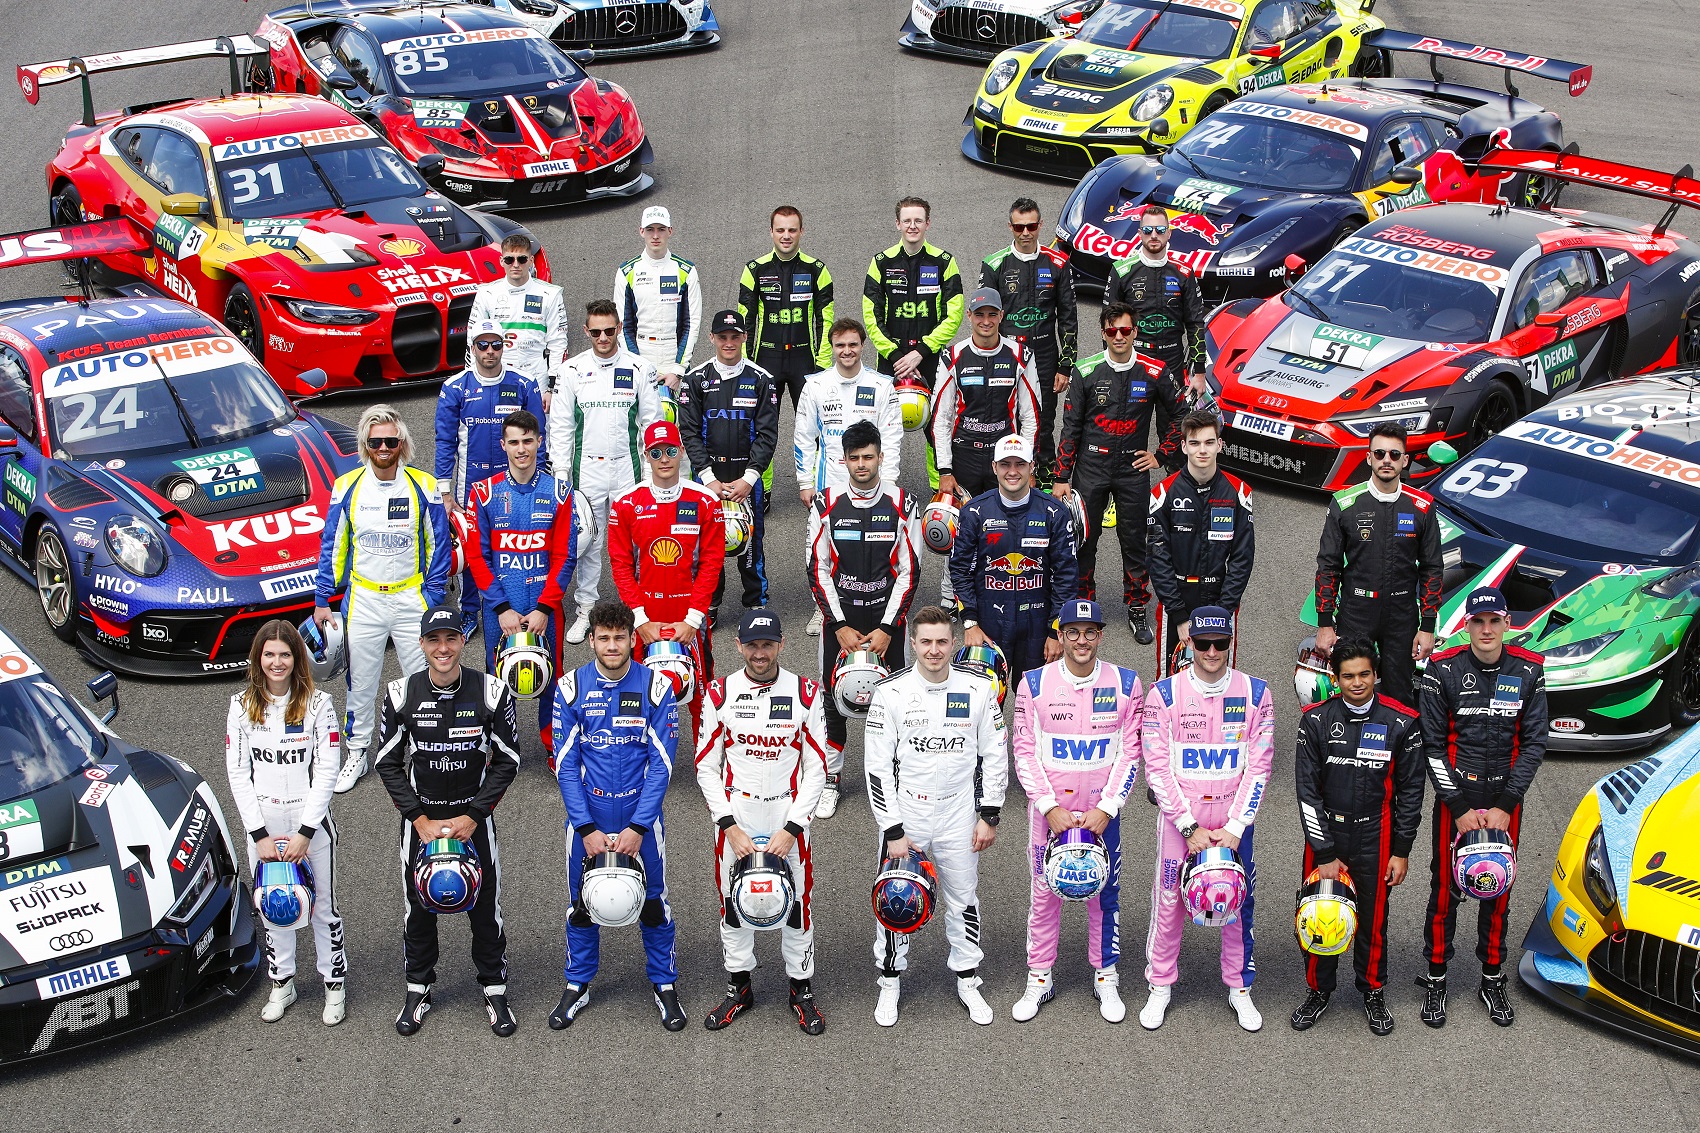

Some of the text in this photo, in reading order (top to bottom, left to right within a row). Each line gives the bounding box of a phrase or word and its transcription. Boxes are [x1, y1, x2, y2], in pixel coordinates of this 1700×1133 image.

[972, 1, 1004, 11] MAHLE
[1350, 23, 1369, 37] SSR
[400, 29, 528, 50] AUTOHERO
[394, 49, 449, 75] 85
[1096, 49, 1142, 60] DEKRA
[1408, 38, 1547, 71] Red Bull
[1084, 64, 1114, 74] DTM
[1300, 60, 1322, 82] EDAG
[1243, 70, 1283, 96] 94 DEKRA
[1571, 79, 1587, 91] avd.de
[1052, 89, 1104, 103] EDAG
[415, 100, 464, 110] DEKRA
[427, 108, 449, 118] 85
[421, 119, 456, 127] DTM
[1023, 118, 1058, 132] MAHLE
[1229, 102, 1360, 135] AUTOHERO
[1184, 120, 1245, 148] 74
[222, 126, 369, 159] AUTOHERO
[531, 162, 569, 173] MAHLE
[228, 163, 285, 205] 31
[1561, 168, 1630, 184] Audi
[1186, 178, 1233, 194] DEKRA
[1189, 187, 1210, 201] 74
[1171, 196, 1204, 210] DTM
[1378, 190, 1425, 215] 74 DEKRA
[247, 219, 303, 227] DEKRA
[260, 226, 285, 235] 31
[1390, 224, 1427, 235] TEAM
[159, 214, 202, 252] DEKRA 31
[157, 233, 175, 254] DTM
[1073, 224, 1140, 259] Red
[1372, 230, 1496, 260] ROSBERG
[162, 257, 178, 275] Shell
[1344, 239, 1501, 282] AUTOHERO
[377, 265, 416, 280] Shell
[382, 267, 472, 293] HELIX
[1303, 258, 1370, 292] 51
[164, 271, 199, 308] HELIX
[451, 284, 478, 294] MAHLE
[397, 293, 426, 305] MAHLE
[769, 307, 803, 324] #92
[896, 300, 929, 319] #94
[35, 303, 194, 338] PAUL
[1006, 313, 1048, 323] BIO-CIRCLE
[106, 326, 216, 350] Team Bernhard
[1319, 326, 1372, 347] DEKRA
[1323, 341, 1350, 363] 51
[54, 339, 234, 388] AUTOHERO
[1287, 357, 1328, 370] DTM
[1524, 358, 1539, 380] 51
[1543, 343, 1574, 368] DEKRA
[1266, 379, 1294, 388] AIRWAYS
[1274, 370, 1324, 389] AUGSBURG
[1553, 366, 1575, 389] DTM
[580, 401, 631, 409] SCHAEFFLER
[1383, 401, 1424, 410] RAVENOL
[63, 386, 144, 443] 24
[706, 409, 750, 420] CATL
[1240, 415, 1287, 436] MAHLE
[180, 450, 249, 469] DEKRA
[1220, 441, 1301, 473] MEDION
[1522, 428, 1700, 482] AUTOHERO
[5, 466, 33, 495] DEKRA
[207, 463, 241, 482] 24
[1443, 458, 1529, 498] 63
[213, 477, 258, 496] DTM
[6, 493, 27, 517] DTM
[390, 504, 408, 513] DTM
[1214, 516, 1232, 524] DTM
[206, 506, 325, 551] KÜS
[381, 532, 409, 547] BUSCH
[260, 556, 317, 572] SIEGERDESIGNS
[500, 554, 544, 570] PAUL
[95, 574, 135, 594] HYLO
[985, 575, 1043, 591] Red Bull
[177, 587, 234, 604] PAUL
[1479, 594, 1496, 604] BWT
[428, 610, 453, 624] ABT
[748, 617, 773, 629] ABT
[1203, 618, 1225, 627] BWT
[142, 623, 165, 638] ixo
[97, 637, 130, 649] RACING
[585, 691, 604, 700] ABT
[757, 686, 771, 696] ABT
[1497, 684, 1519, 693] DTM
[417, 701, 437, 710] ABT
[736, 693, 753, 703] ABT
[1094, 696, 1116, 704] DTM
[1225, 706, 1245, 714] DTM
[1476, 708, 1518, 717] AMG
[588, 734, 640, 744] SCHERER
[737, 734, 787, 748] SONAX
[1363, 732, 1385, 741] DTM
[252, 747, 307, 765] ROKiT
[1052, 738, 1111, 760] BWT
[430, 757, 467, 772] FUJITSU
[1182, 748, 1240, 769] BWT
[763, 795, 779, 803] RAST
[176, 807, 206, 866] REMUS
[5, 860, 62, 885] DTM
[1164, 858, 1172, 889] CHANGE
[9, 881, 87, 912] FUJITSU
[49, 959, 120, 995] MAHLE
[29, 980, 134, 1054] ABT
